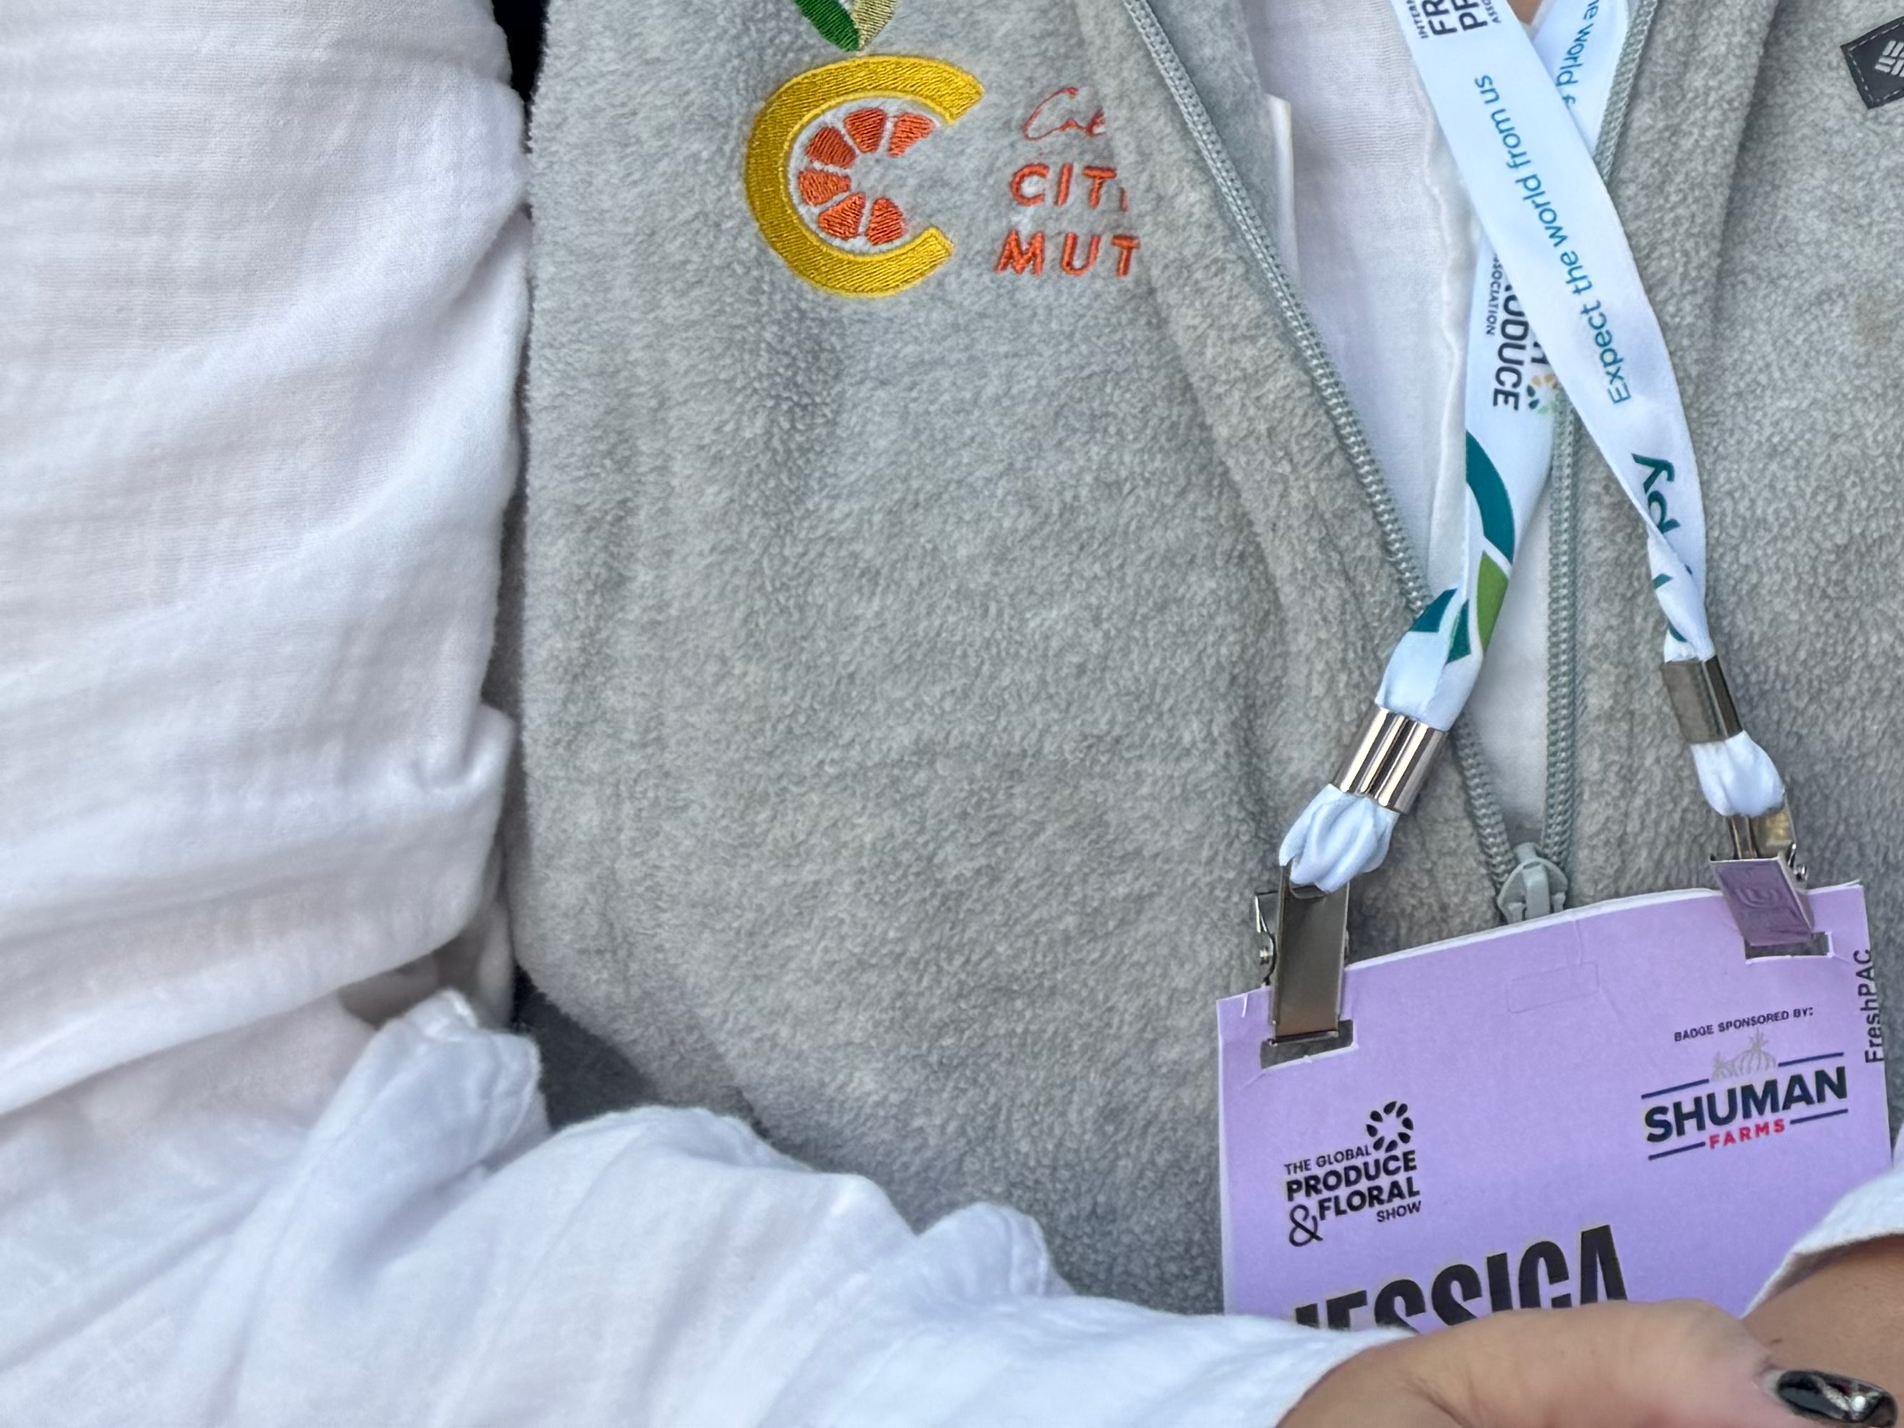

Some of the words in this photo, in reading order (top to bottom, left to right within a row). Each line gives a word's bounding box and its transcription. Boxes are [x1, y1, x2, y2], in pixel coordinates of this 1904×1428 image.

[1556, 23, 1595, 86] world
[1474, 75, 1503, 105] us
[1493, 108, 1533, 172] from
[1516, 174, 1572, 248] world
[1486, 253, 1503, 336] SOCIATION
[1560, 250, 1594, 294] the
[1492, 284, 1530, 411] ODUCE
[1581, 300, 1631, 405] Expect
[1674, 1024, 1715, 1042] BADGE
[1718, 1010, 1790, 1033] SPONSORED
[1853, 949, 1885, 1063] FreshPAC
[1644, 1066, 1848, 1143] SHUMAN
[1709, 1118, 1786, 1150] FARMS
[1284, 1158, 1312, 1175] THE
[1316, 1145, 1372, 1168] GLOBAL
[1286, 1150, 1417, 1202] PRODUCE
[1288, 1204, 1323, 1247] &
[1318, 1176, 1420, 1221] FLORAL
[1377, 1200, 1421, 1223] SHOW
